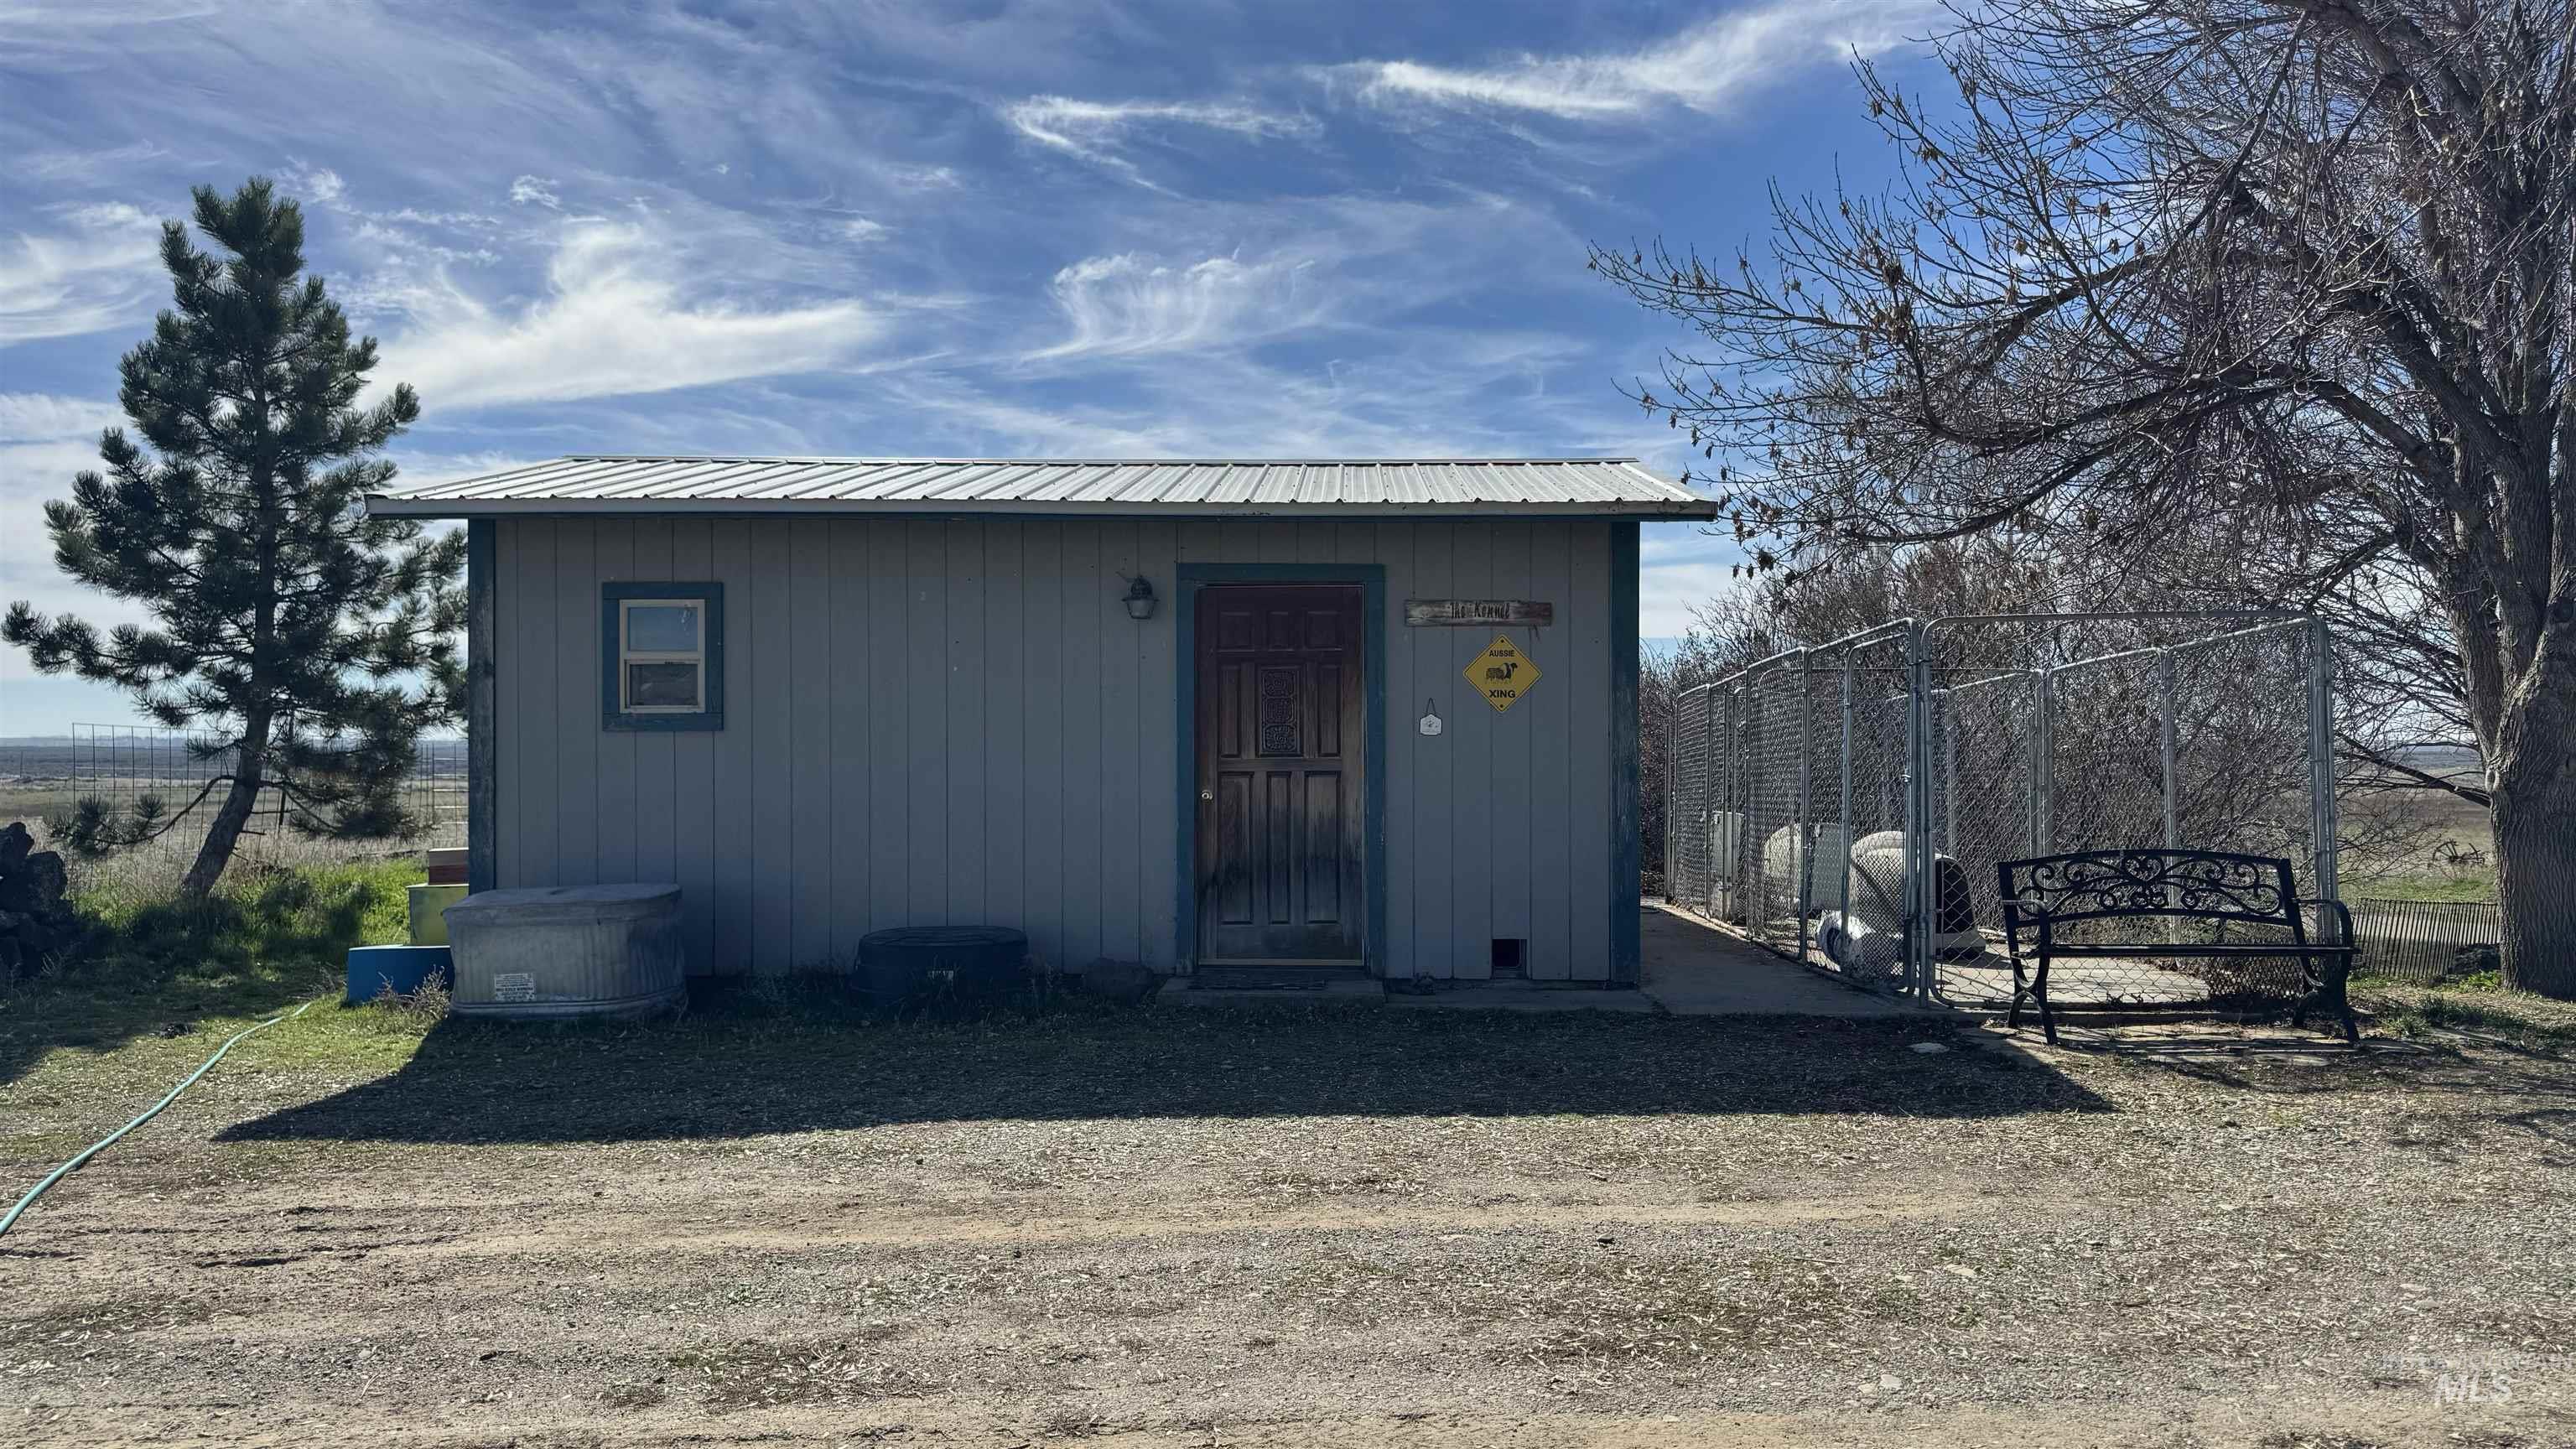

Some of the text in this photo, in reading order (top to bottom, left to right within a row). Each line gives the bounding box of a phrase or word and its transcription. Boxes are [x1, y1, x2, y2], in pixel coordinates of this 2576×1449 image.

[1450, 601, 1510, 619] The Kennel
[1489, 690, 1515, 699] XING
